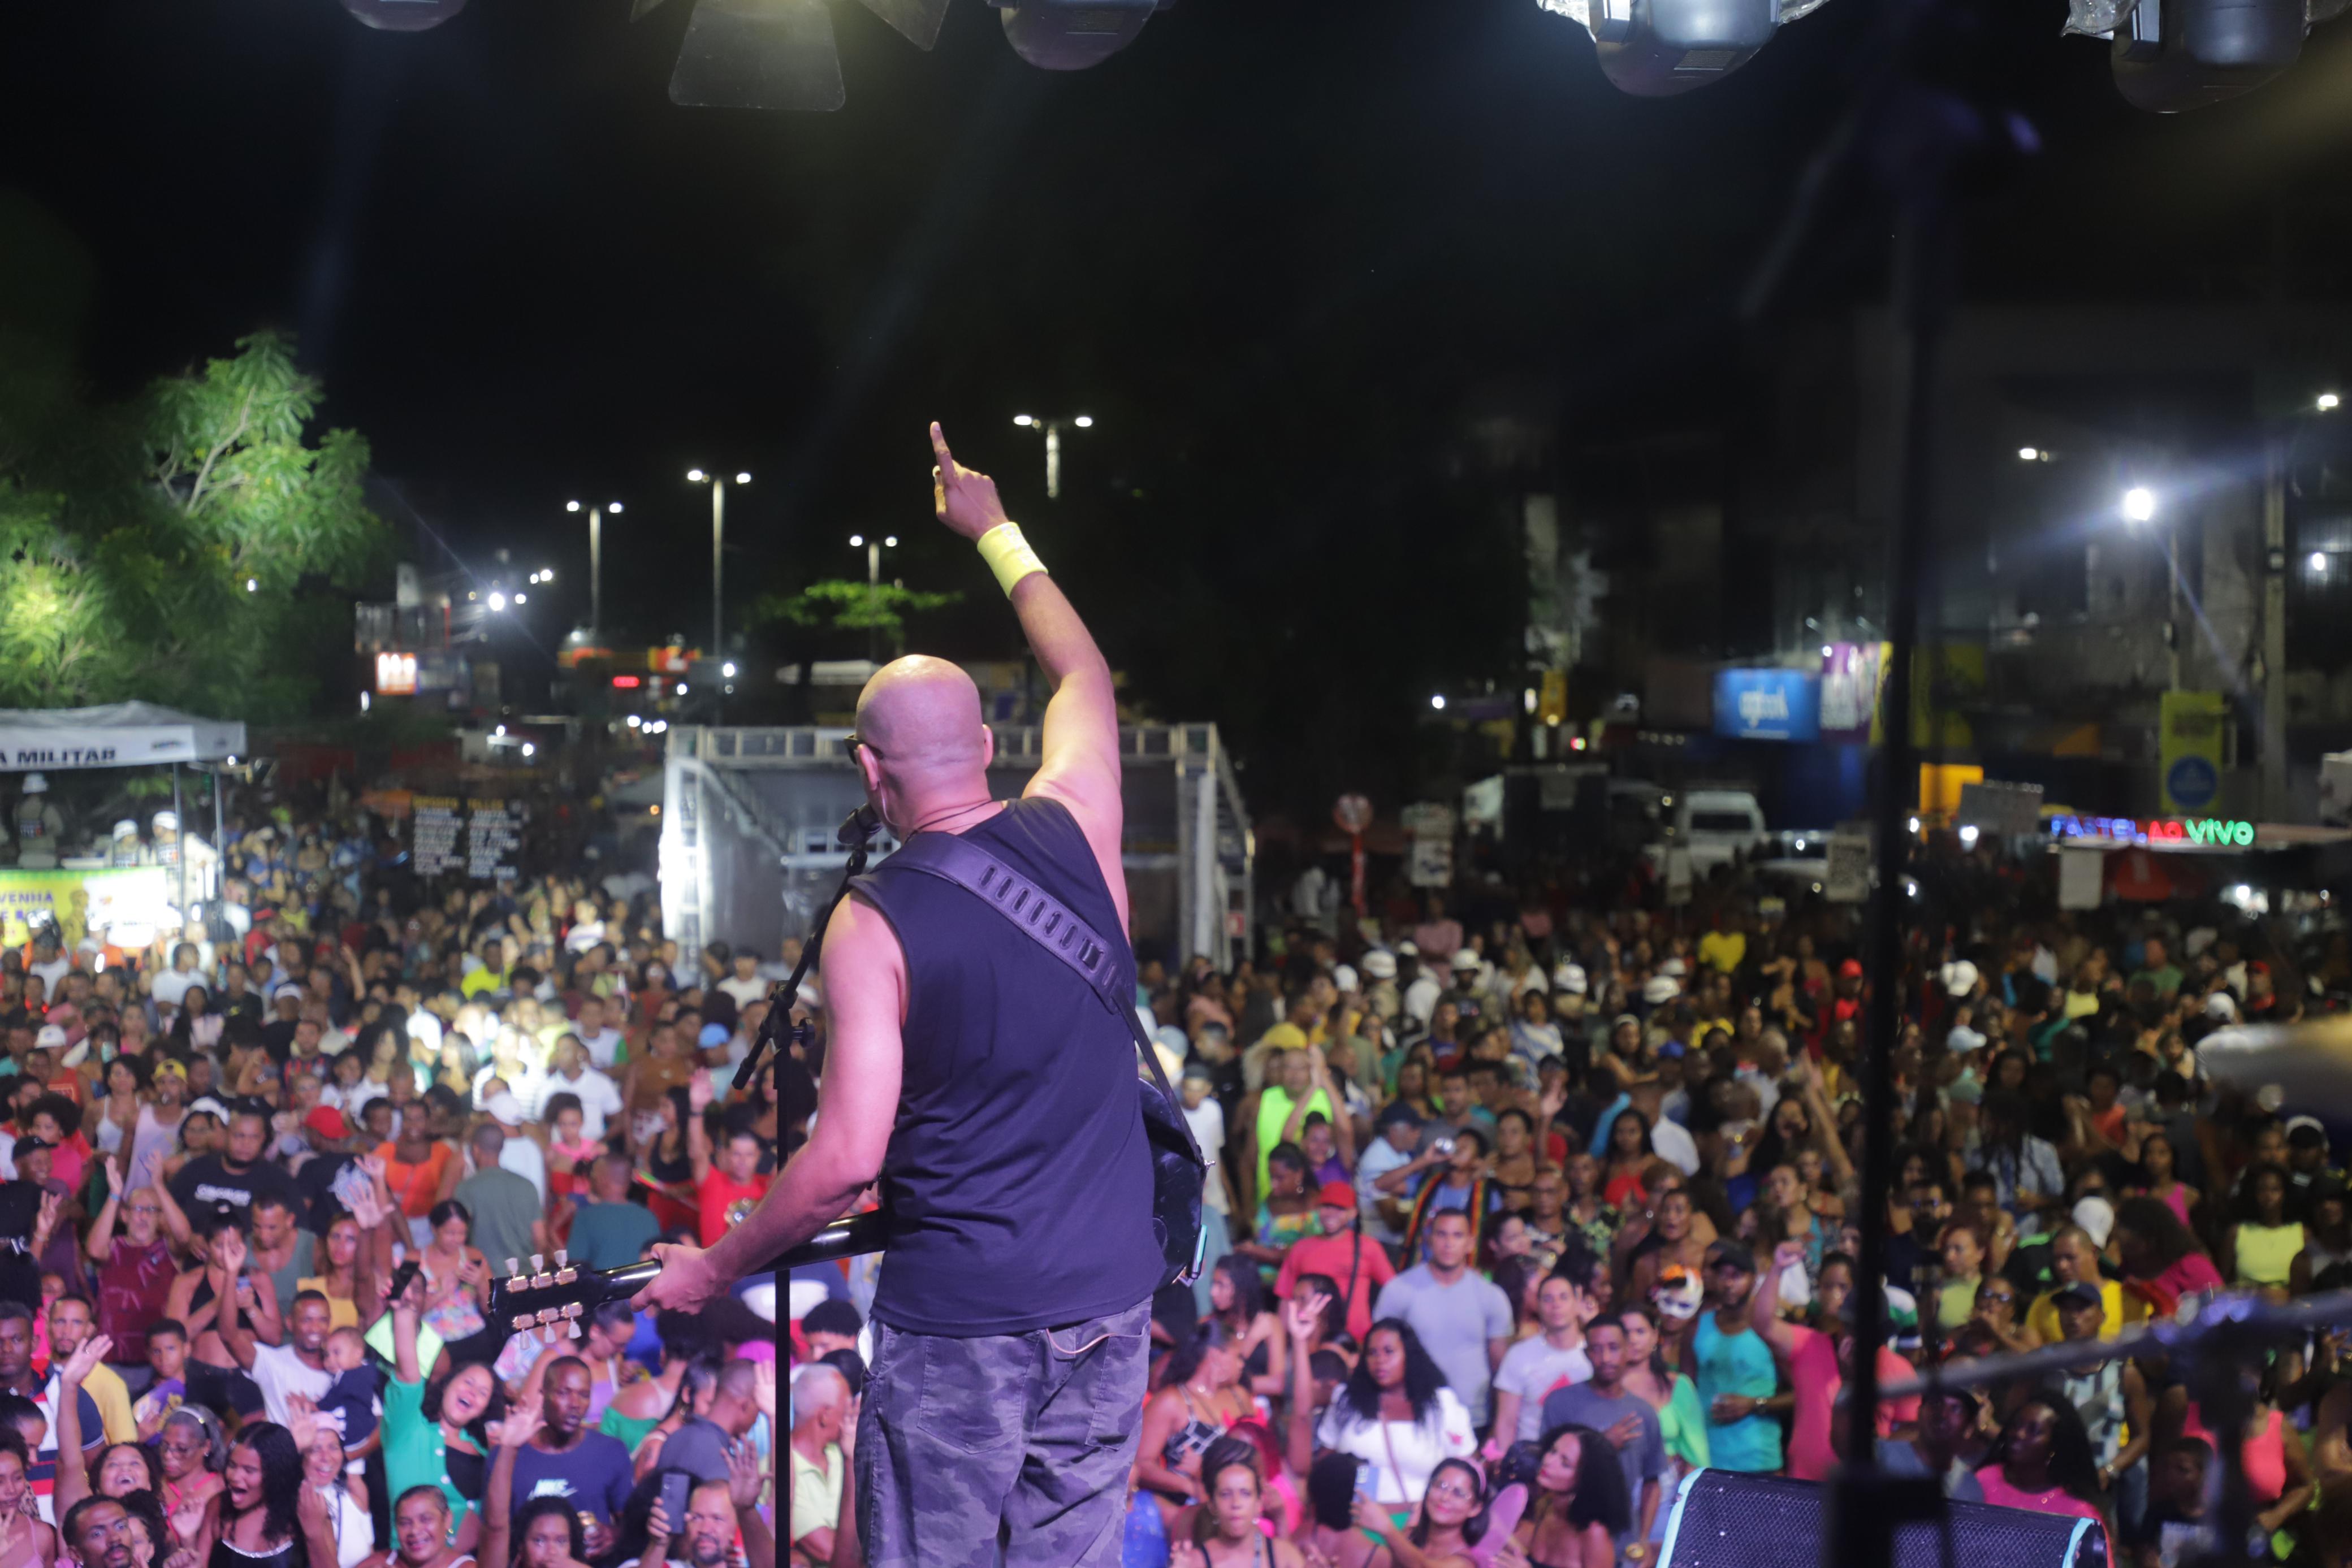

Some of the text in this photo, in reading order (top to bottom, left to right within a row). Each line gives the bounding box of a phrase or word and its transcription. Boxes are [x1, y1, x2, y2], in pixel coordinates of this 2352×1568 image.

[17, 747, 116, 763] MILITAR
[2148, 820, 2183, 844] AO
[2185, 818, 2254, 846] VIVO
